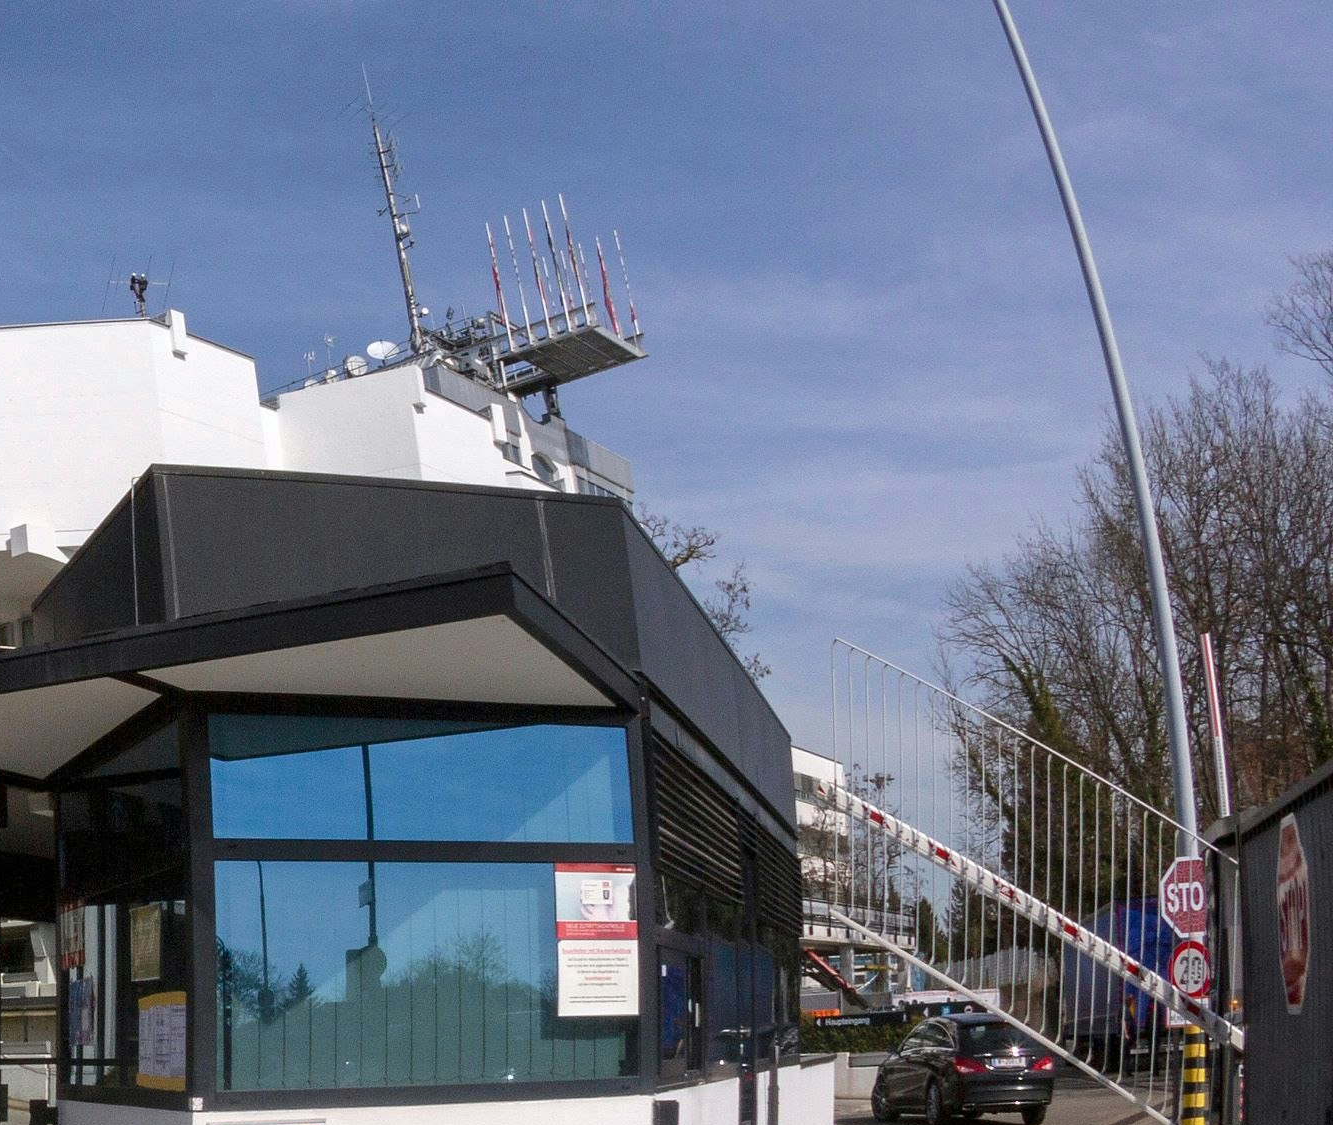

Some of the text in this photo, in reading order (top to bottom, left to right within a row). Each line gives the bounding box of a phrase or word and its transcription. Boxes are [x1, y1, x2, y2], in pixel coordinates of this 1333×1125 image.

[1167, 881, 1204, 913] STO
[1179, 955, 1202, 985] 20
[825, 1017, 870, 1026] Haupteingang
